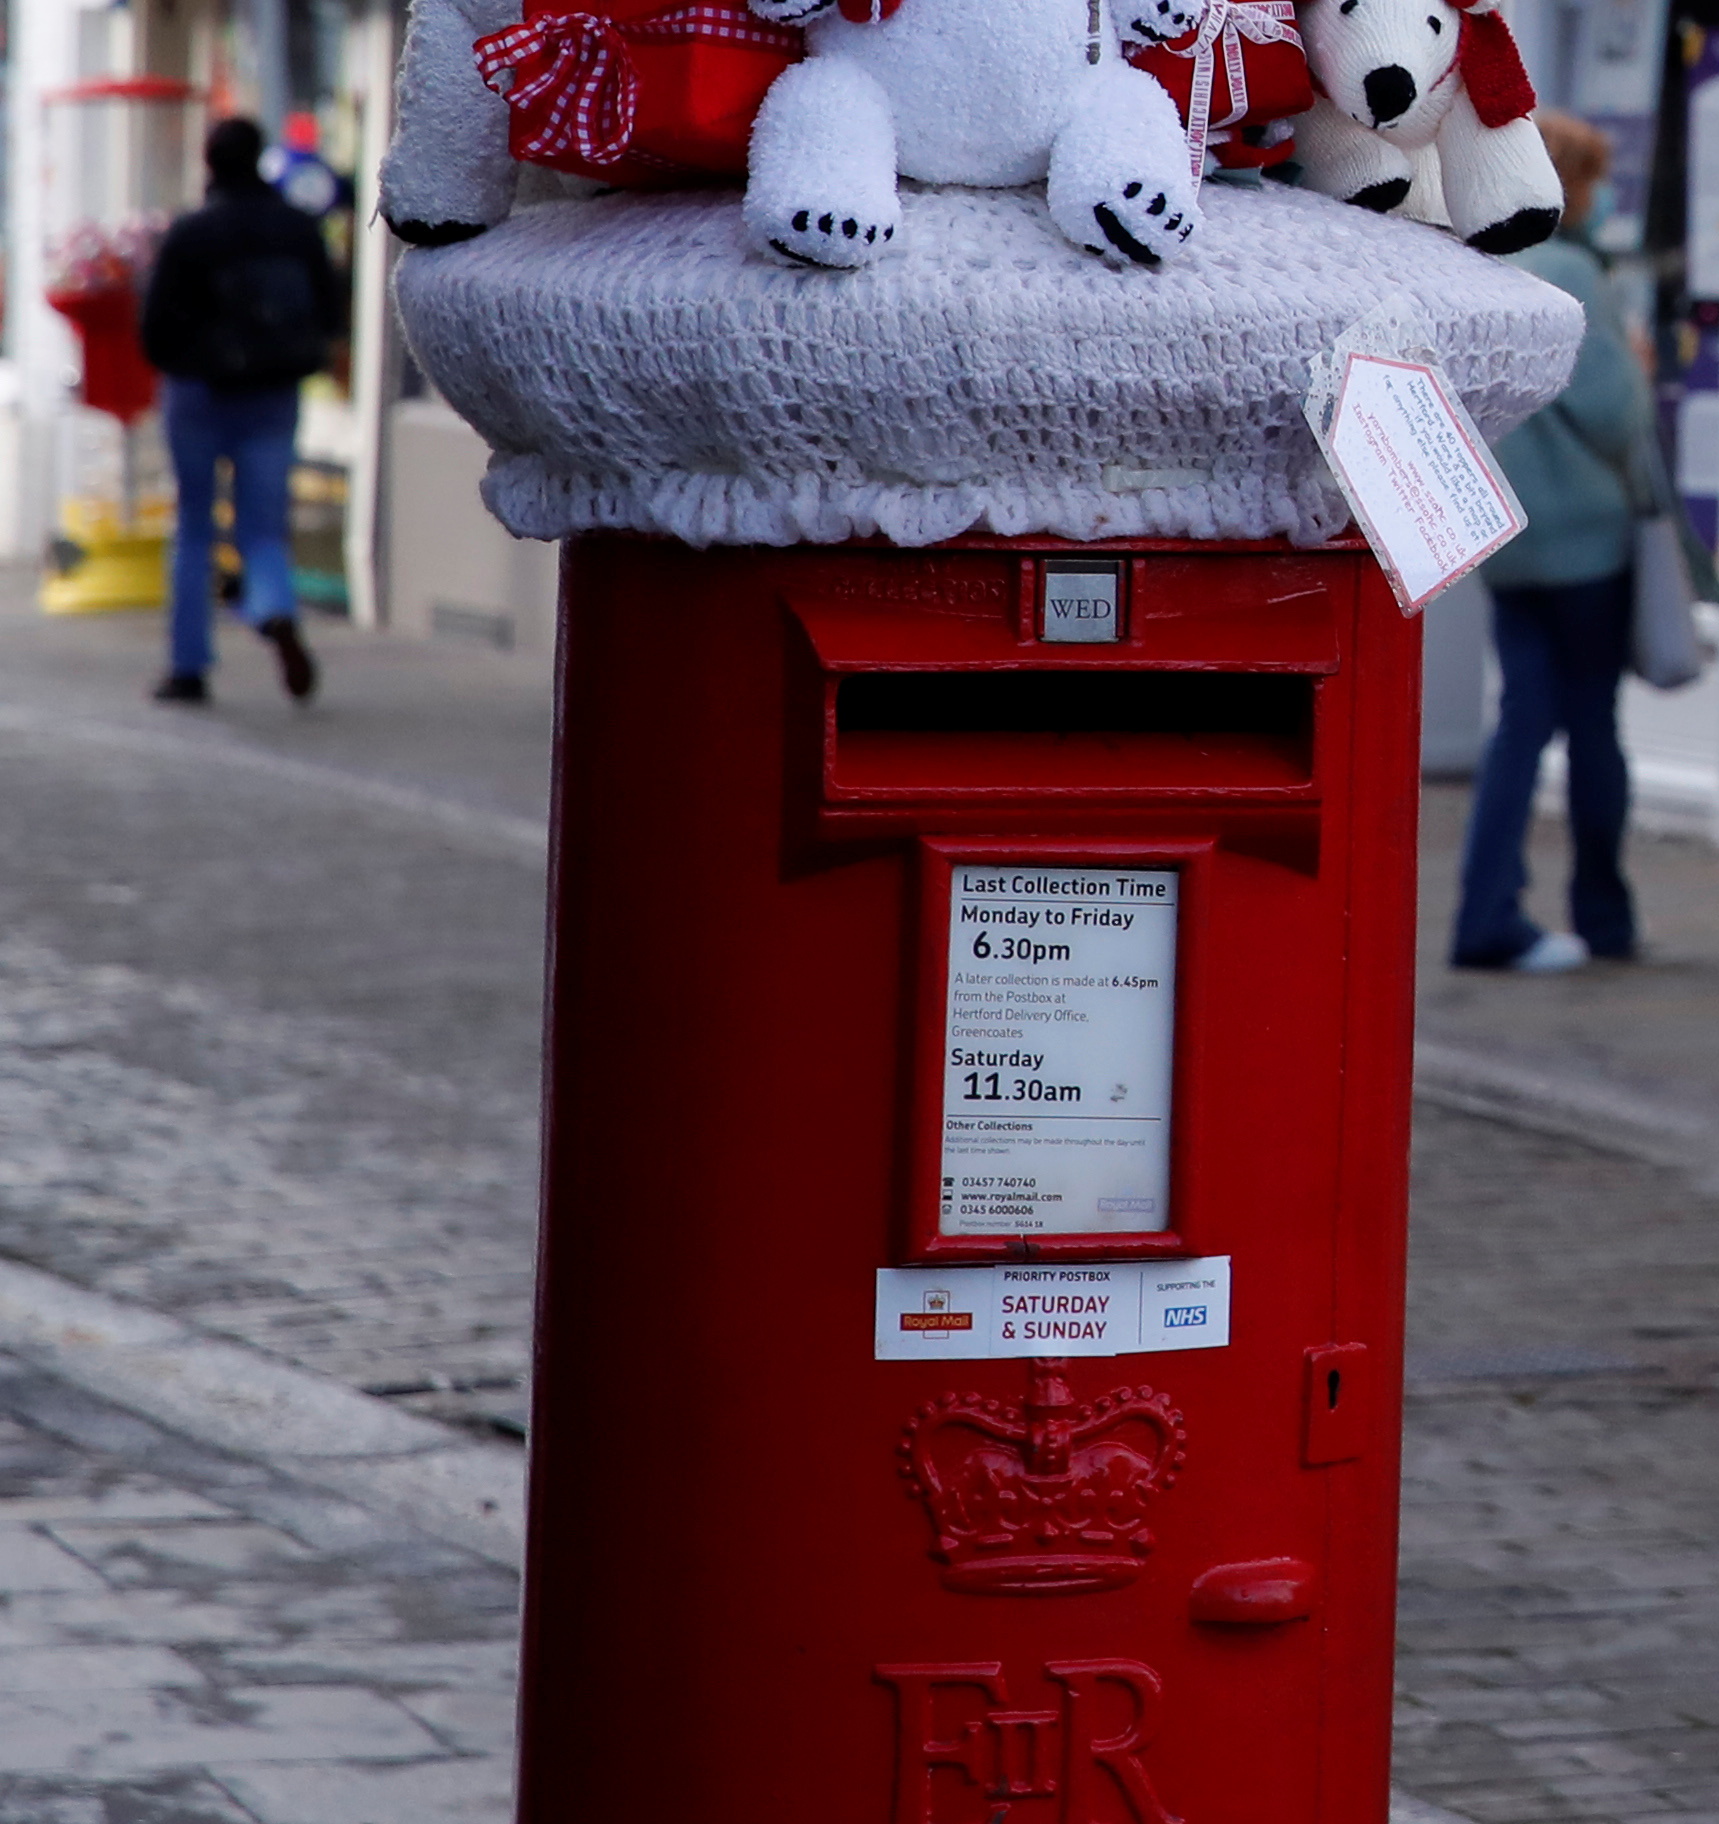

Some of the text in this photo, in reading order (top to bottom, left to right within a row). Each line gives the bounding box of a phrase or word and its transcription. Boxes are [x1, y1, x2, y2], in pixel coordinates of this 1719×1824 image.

[1382, 374, 1394, 392] for
[1393, 394, 1417, 436] anything
[1417, 438, 1430, 457] else
[1428, 460, 1450, 490] please
[1449, 493, 1465, 513] find
[1463, 516, 1473, 527] us
[1417, 377, 1506, 529] There are 40 toppers all round
[1415, 415, 1425, 423] if
[1420, 426, 1434, 445] you
[1433, 447, 1452, 474] would
[1449, 475, 1462, 494] like
[1462, 496, 1468, 504] a
[1468, 505, 1482, 526] map
[1480, 528, 1489, 540] or
[1436, 431, 1453, 459] Ware
[1465, 481, 1477, 497] bit
[1475, 499, 1499, 535] beyond
[1351, 403, 1449, 574] Instagram Twitter Facebook
[1050, 598, 1112, 620] WED
[963, 874, 1166, 897] Last Collection Time
[961, 905, 1134, 930] Monday to Friday
[973, 930, 1070, 965] 6.30pm
[954, 973, 1159, 990] A later collection is made at 6.45pm
[954, 990, 1066, 1004] from the Postbox at
[953, 1008, 1002, 1020] Hertford
[1005, 1008, 1052, 1023] Delivery
[952, 1025, 1023, 1038] Greencoates
[951, 1048, 1044, 1071] Saturday
[963, 1072, 1081, 1102] 11.30am
[946, 1120, 1033, 1131] Other Collections
[945, 1135, 979, 1144] Additional
[980, 1136, 1016, 1145] collections
[1017, 1137, 1033, 1147] may
[1034, 1137, 1042, 1145] be
[1044, 1137, 1063, 1146] made
[1064, 1137, 1102, 1148] throughout
[1104, 1137, 1116, 1146] the
[957, 1147, 969, 1155] last
[970, 1147, 986, 1155] time
[962, 1178, 1036, 1188] 03457 740740
[961, 1192, 1062, 1203] www.royalmail.com
[960, 1205, 1034, 1215] 0345 6000606
[1004, 1271, 1111, 1282] PRIORITY POSTBOX
[1156, 1280, 1216, 1293] SUPPORTING THE
[1001, 1295, 1109, 1313] SATURDAY
[903, 1314, 969, 1329] Royal Mail
[1165, 1307, 1206, 1326] NHS
[1002, 1321, 1108, 1340] & SUNDAY
